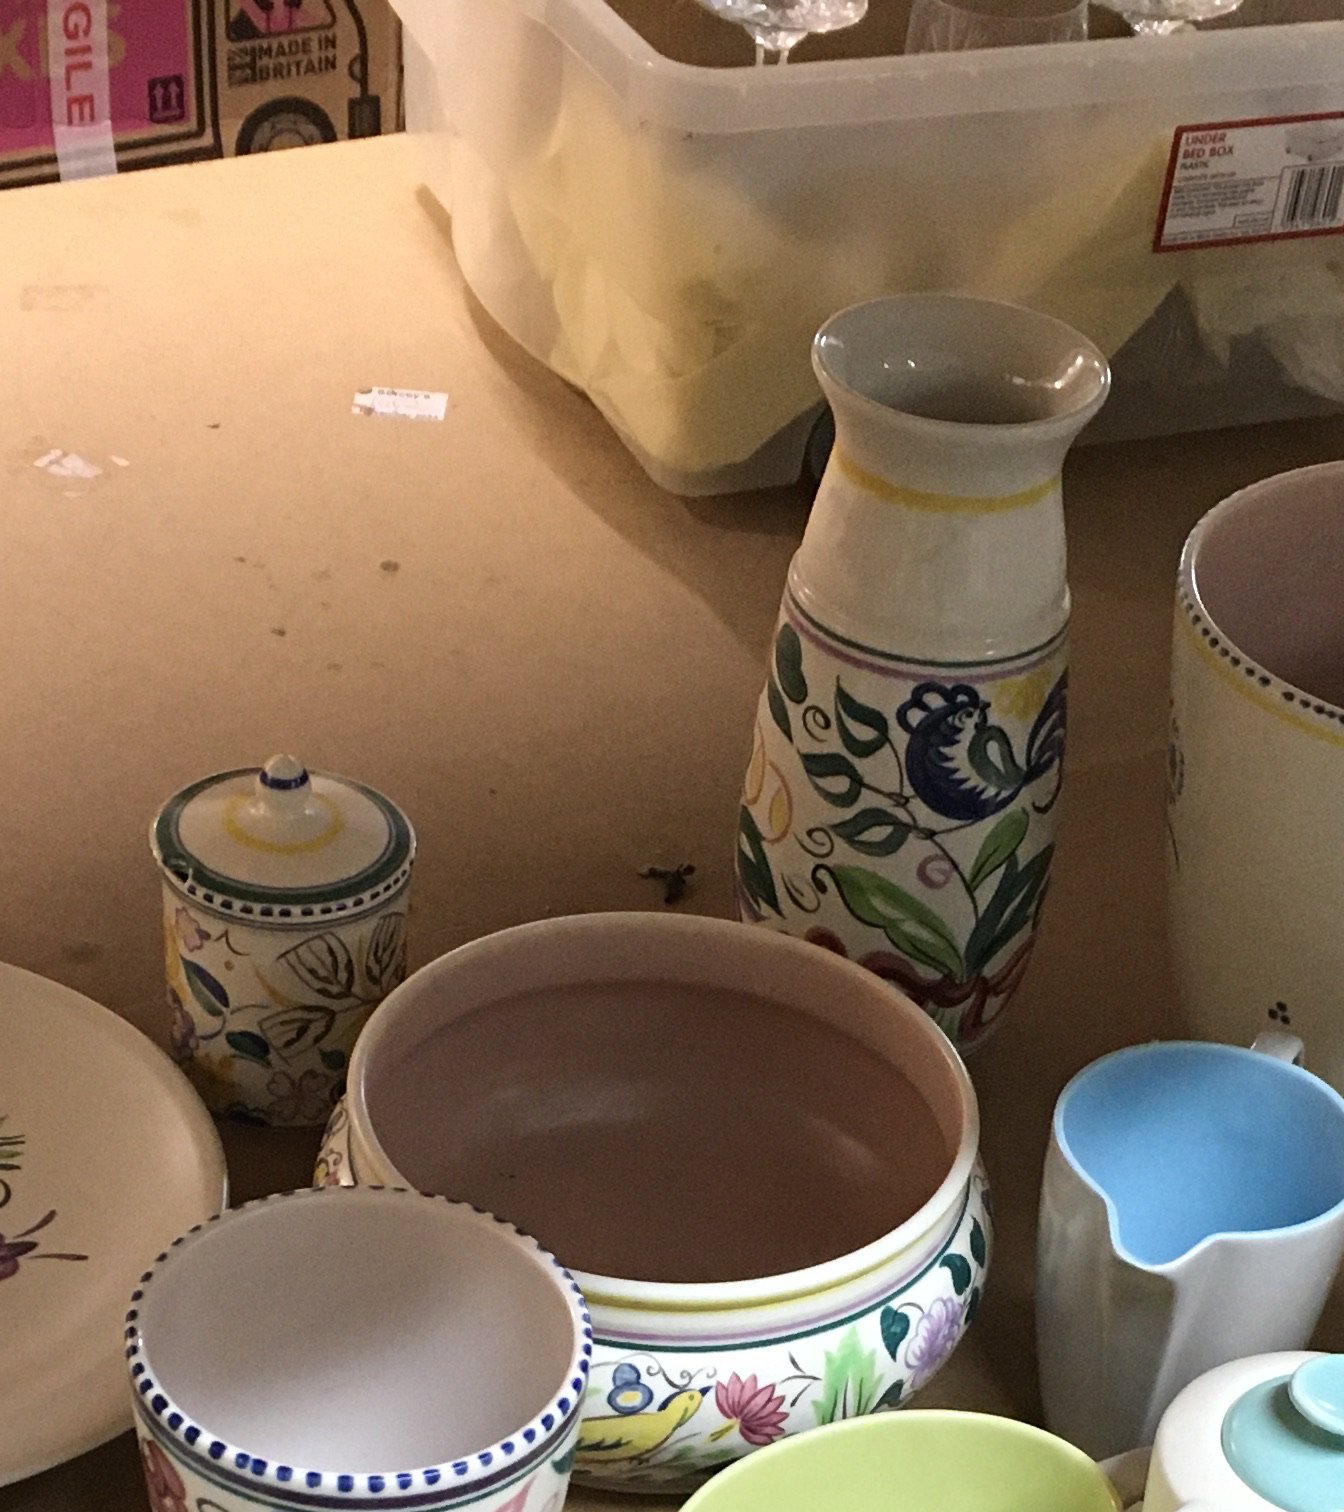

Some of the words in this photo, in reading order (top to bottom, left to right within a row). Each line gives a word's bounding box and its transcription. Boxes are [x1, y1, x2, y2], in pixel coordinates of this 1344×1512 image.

[257, 36, 312, 60] MADE
[317, 32, 337, 51] IN
[258, 53, 337, 81] BRITAIN
[1184, 132, 1227, 146] UNDER
[1182, 147, 1206, 160] BED
[1209, 145, 1234, 158] BOX
